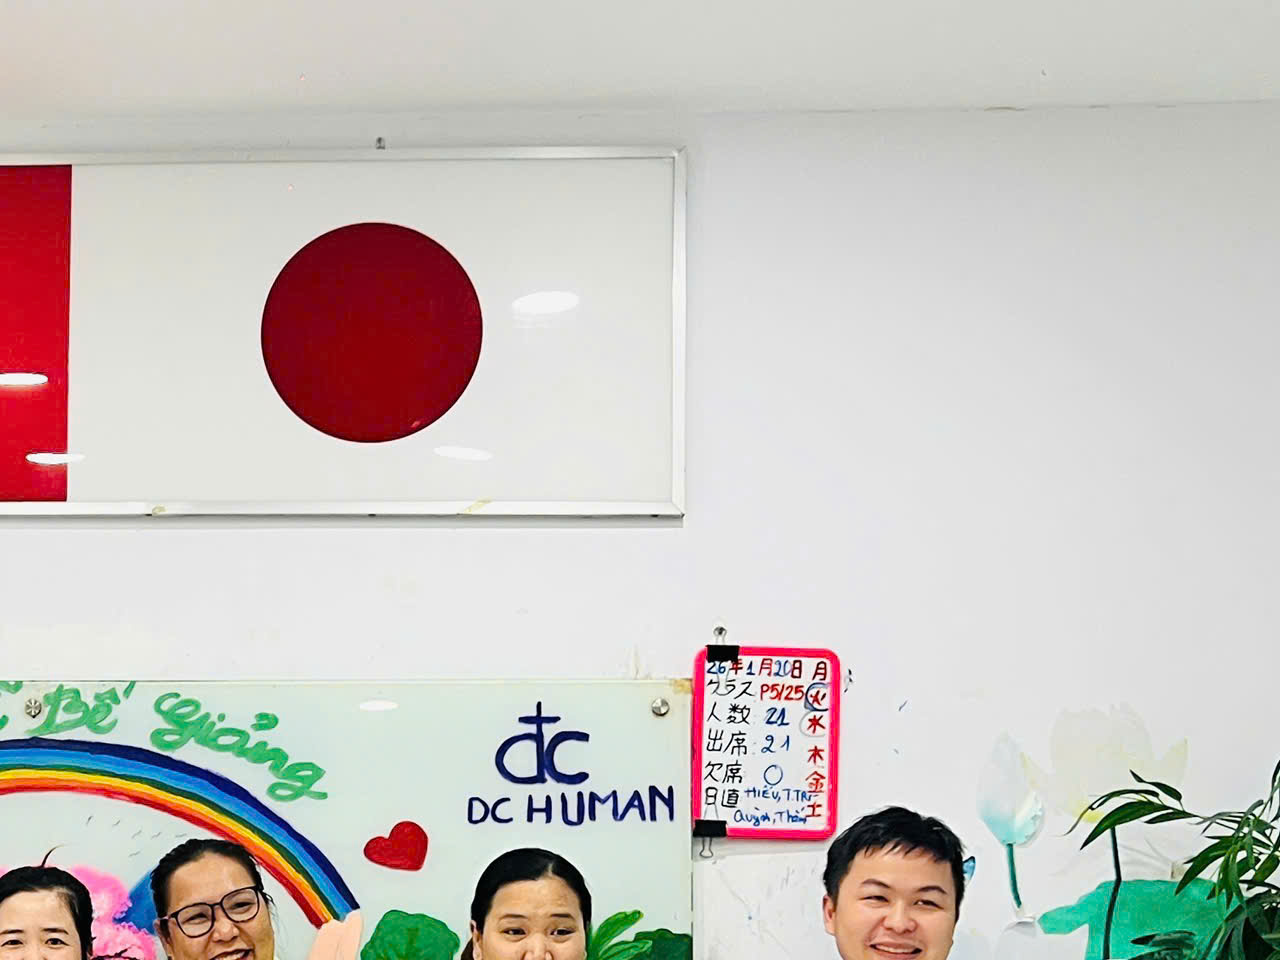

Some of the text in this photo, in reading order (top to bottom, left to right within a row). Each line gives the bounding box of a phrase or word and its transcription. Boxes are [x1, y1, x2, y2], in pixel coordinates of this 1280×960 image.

[706, 680, 804, 701] クラス P5/25
[765, 707, 790, 726] 21
[706, 728, 790, 757] 出席 21
[467, 785, 674, 826] DC HUMAN
